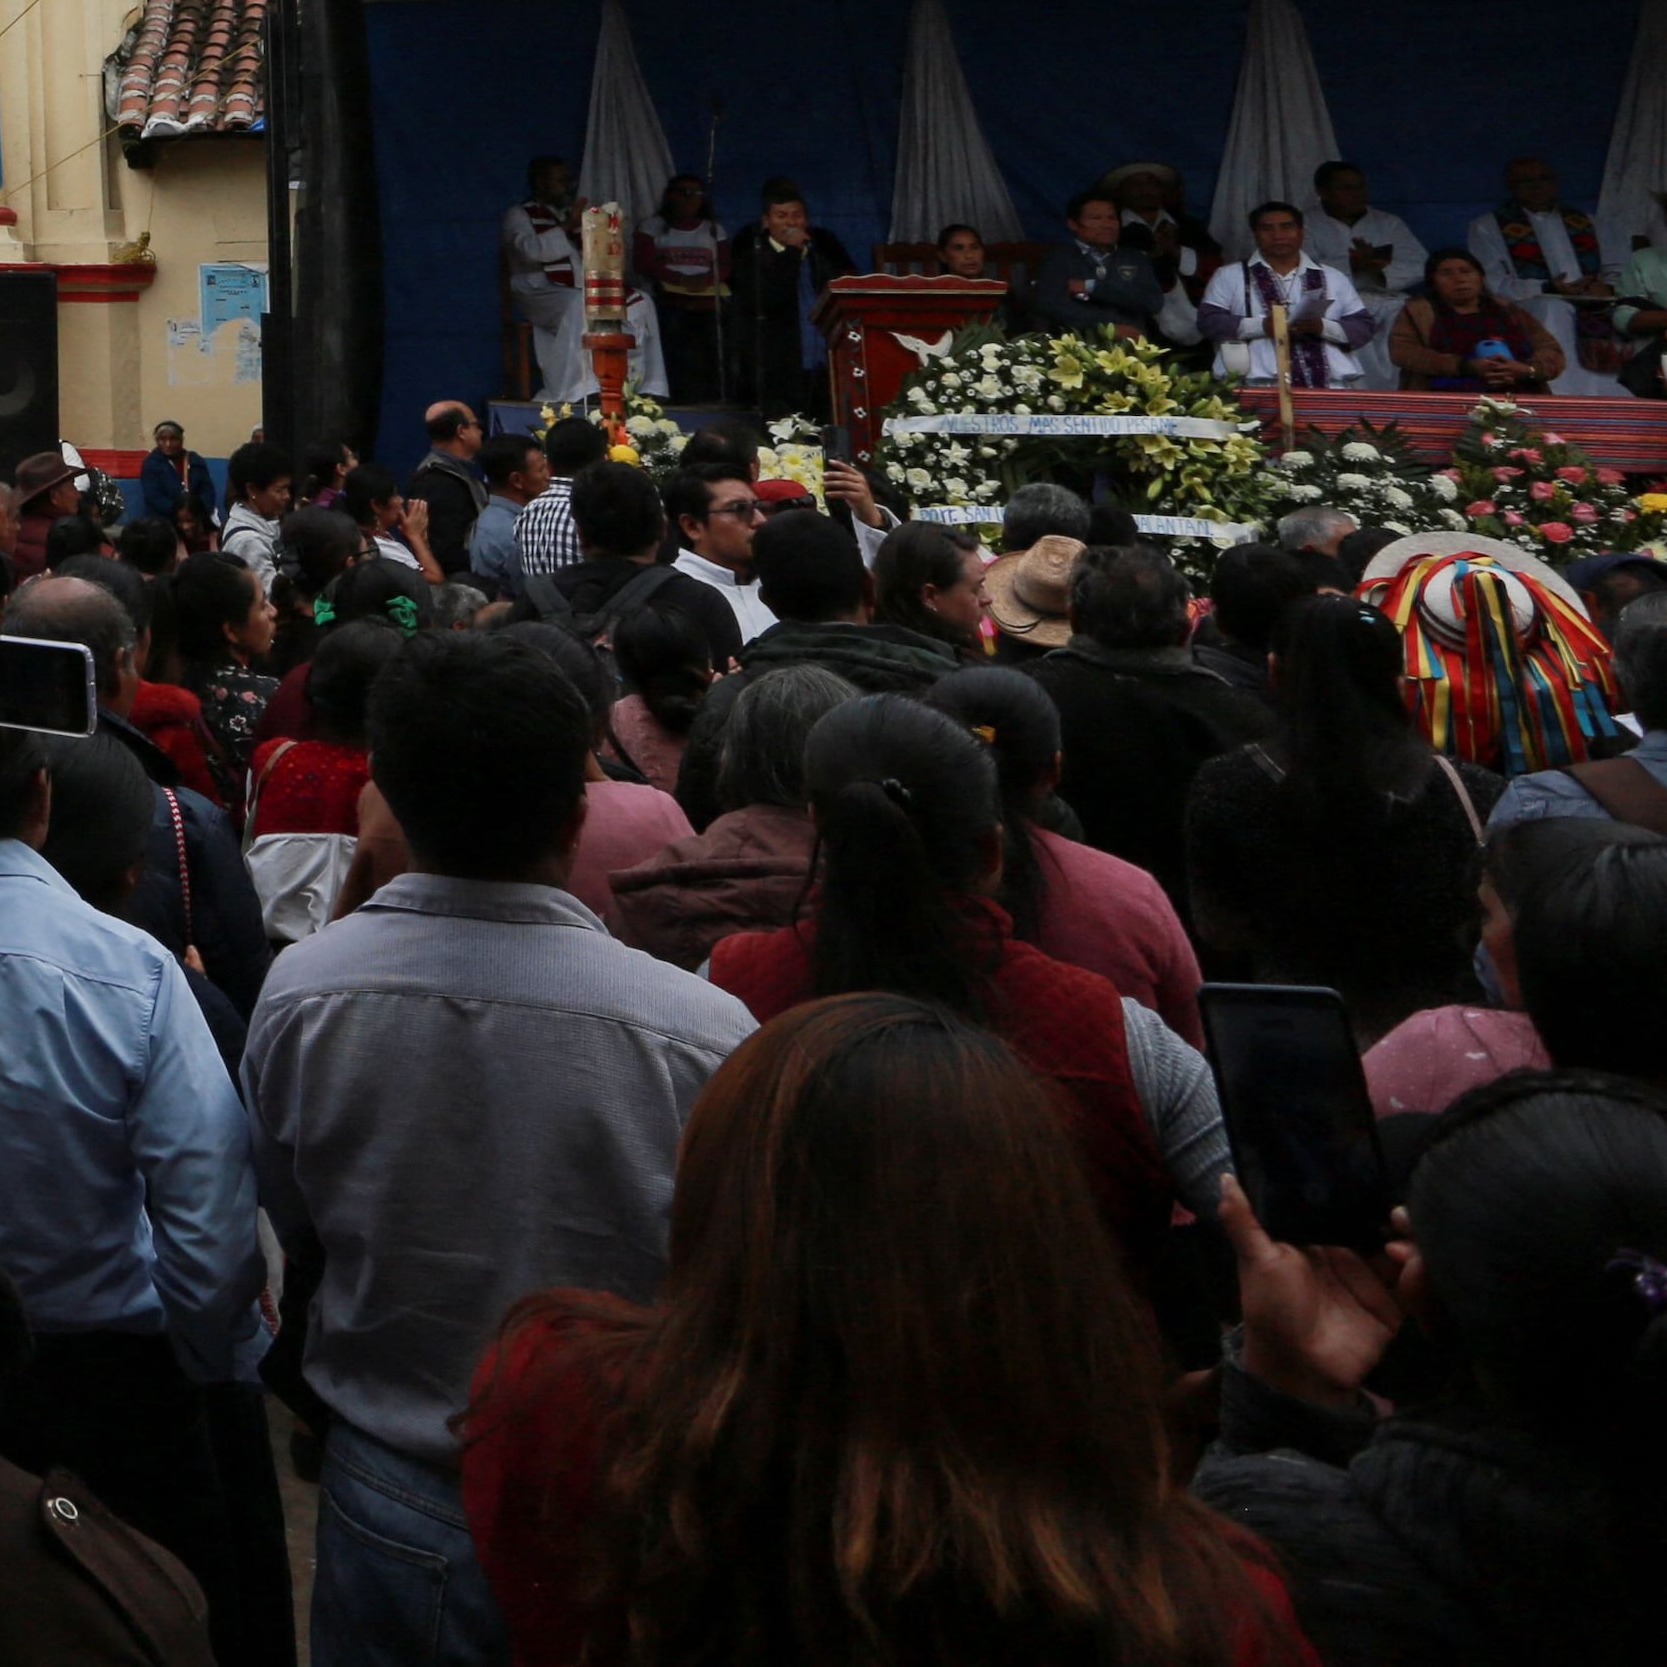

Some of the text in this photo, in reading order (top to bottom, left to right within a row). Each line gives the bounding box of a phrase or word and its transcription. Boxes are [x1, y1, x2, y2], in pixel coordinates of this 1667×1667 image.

[941, 415, 1019, 433] NUESTROS
[1063, 417, 1121, 433] SENTIDO
[1127, 417, 1178, 435] PESAME
[963, 506, 992, 522] SAN
